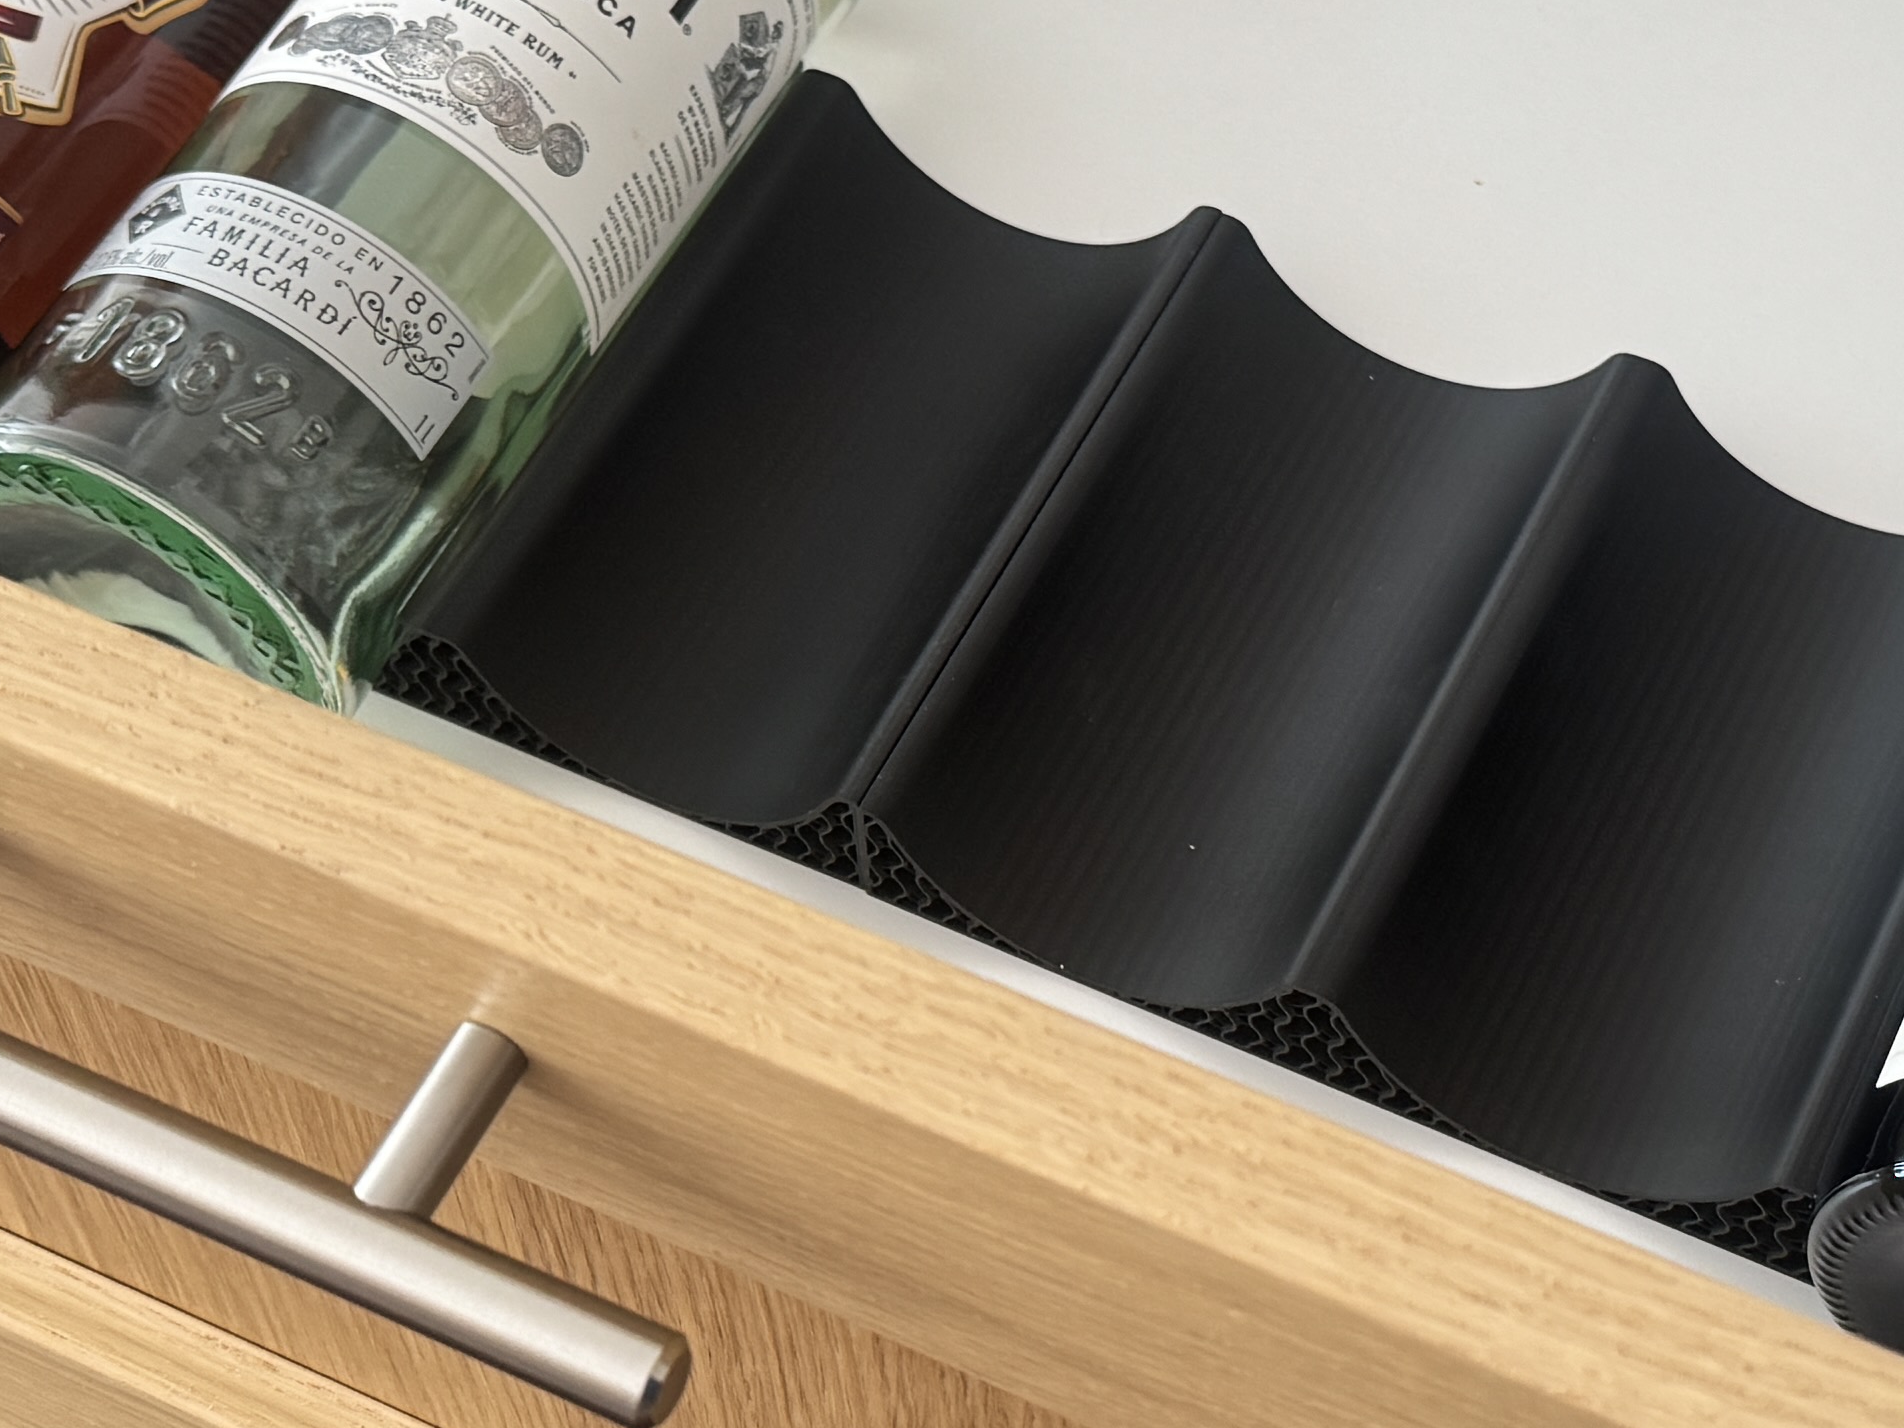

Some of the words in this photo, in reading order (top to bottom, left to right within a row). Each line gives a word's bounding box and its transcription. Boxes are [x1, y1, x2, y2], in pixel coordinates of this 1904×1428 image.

[522, 35, 565, 70] RUM
[182, 215, 310, 278] FAMILIA
[196, 185, 347, 247] ESTABLECIDO
[355, 245, 384, 272] EN
[389, 274, 467, 358] 1862
[204, 203, 235, 222] UNA
[237, 210, 310, 249] EMPRESA
[311, 243, 333, 262] DE
[335, 257, 355, 274] LA
[206, 248, 360, 337] BACARDÍ
